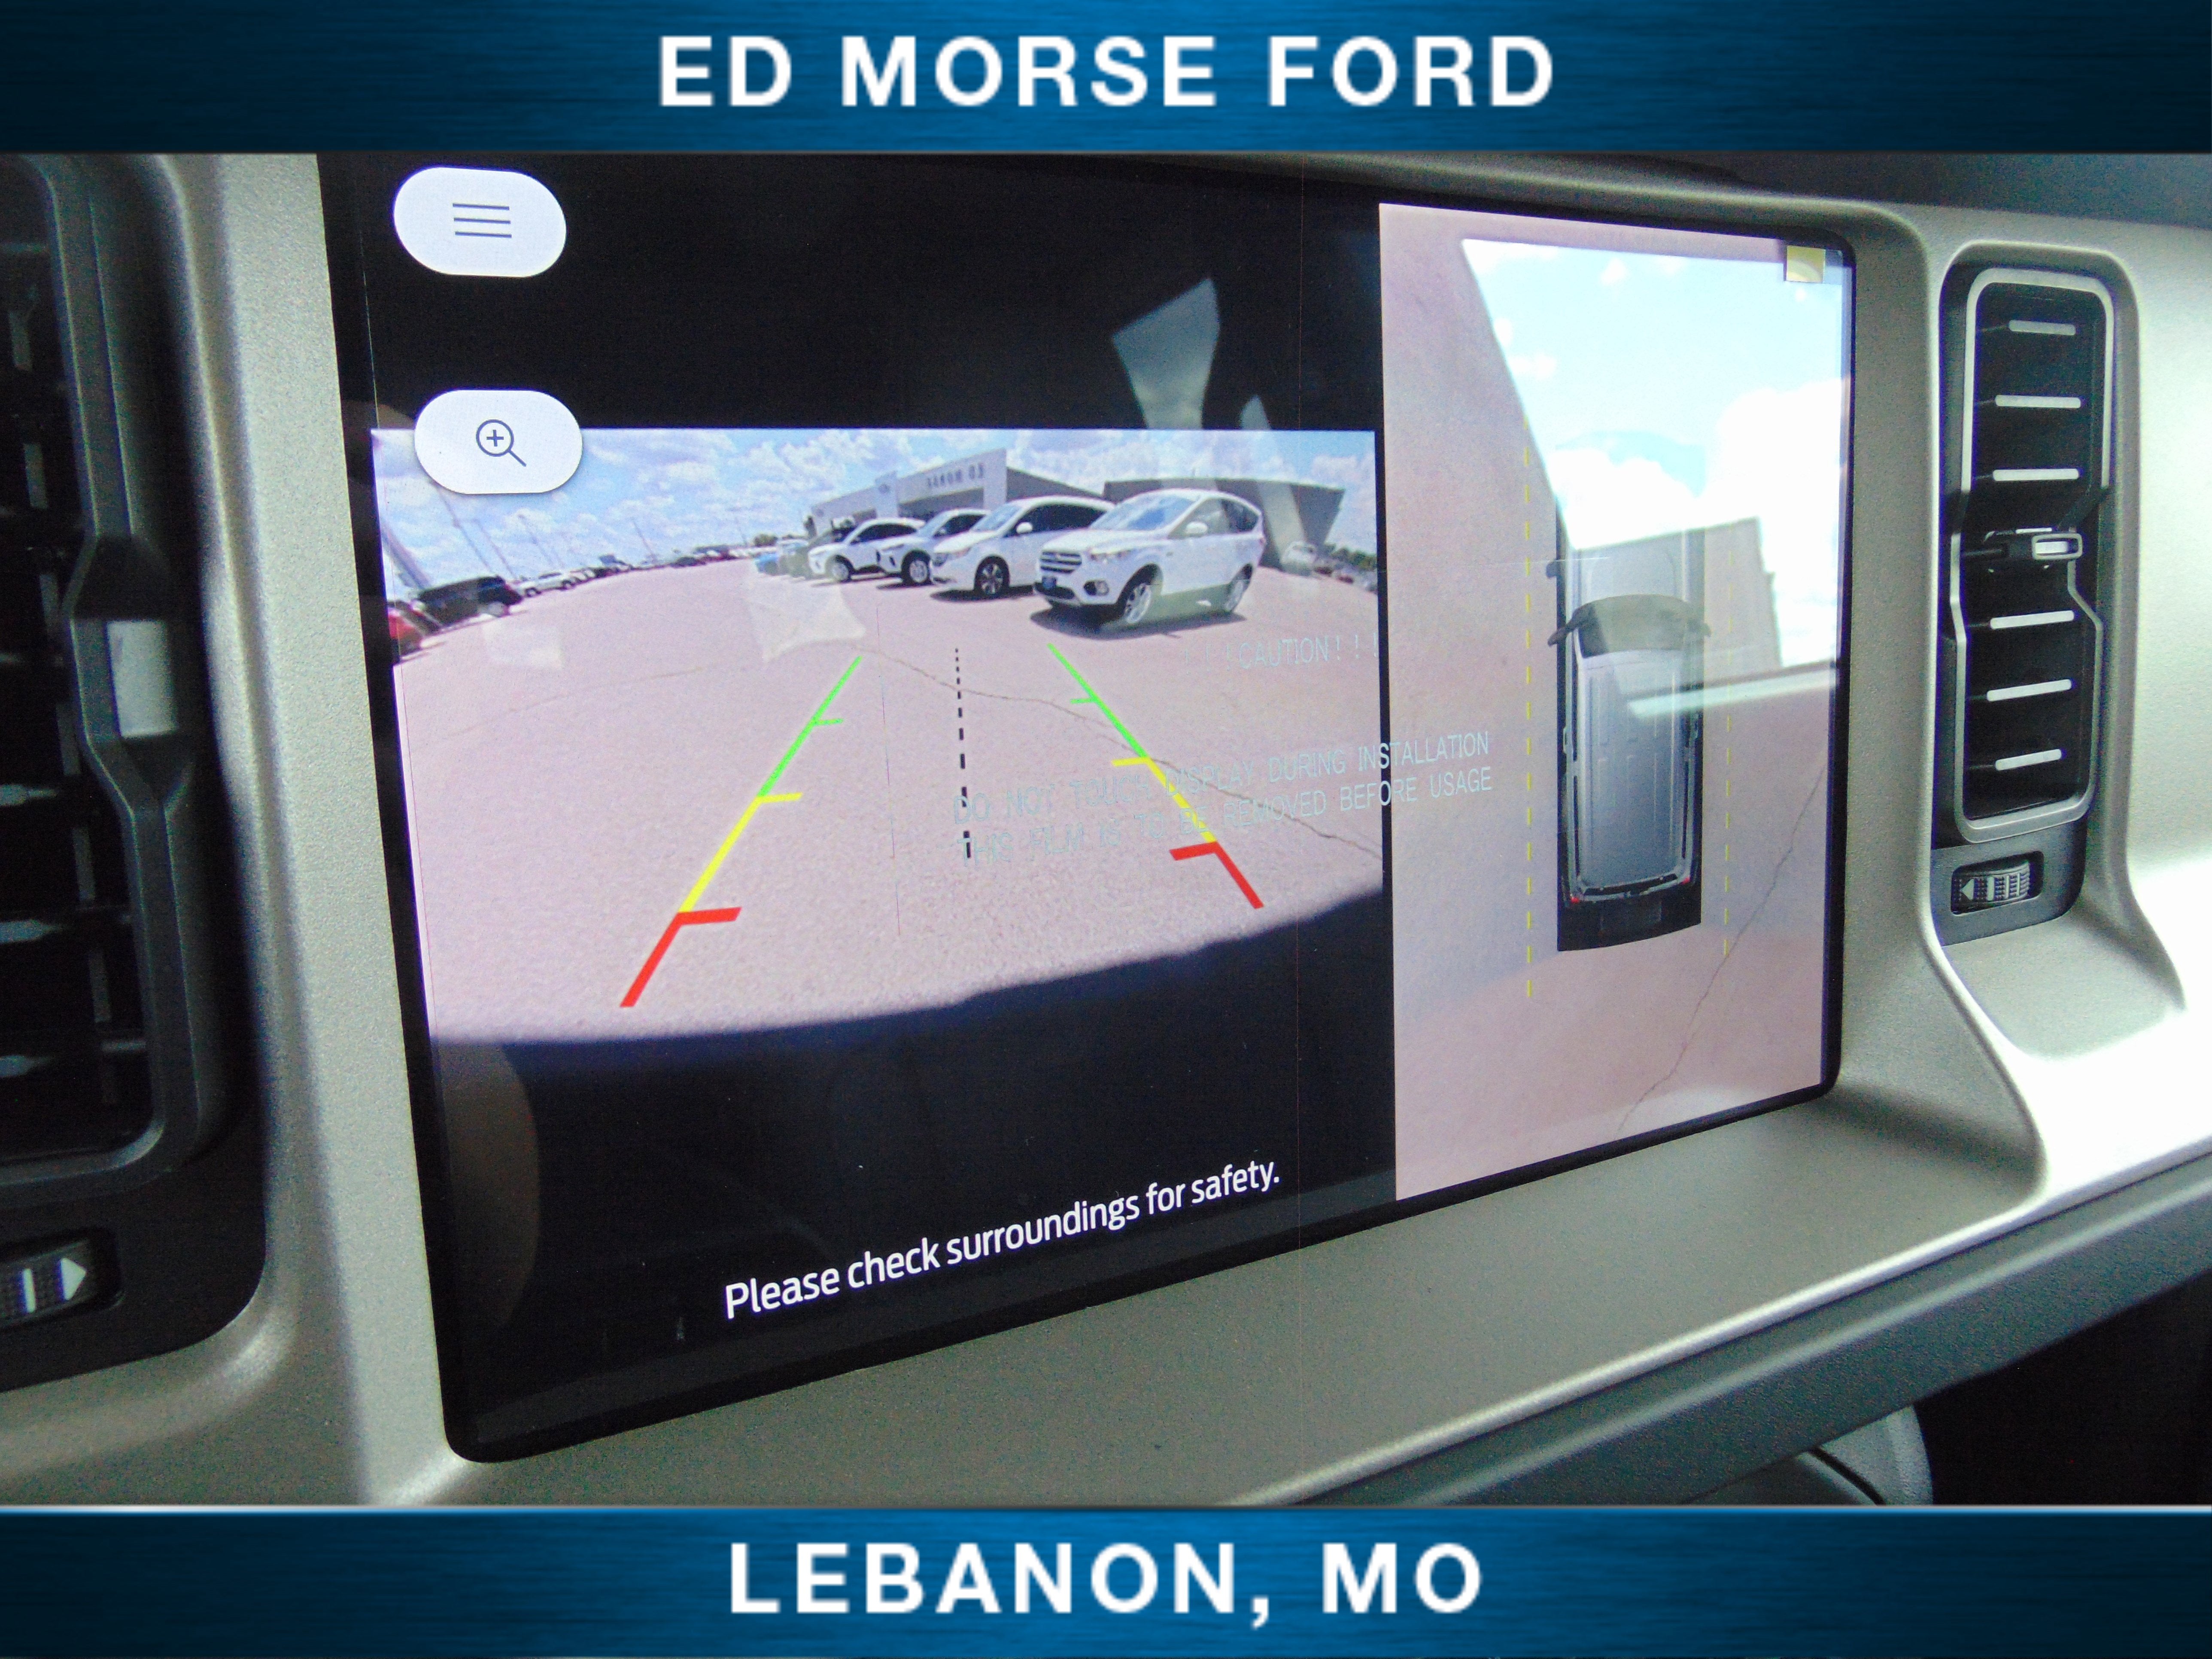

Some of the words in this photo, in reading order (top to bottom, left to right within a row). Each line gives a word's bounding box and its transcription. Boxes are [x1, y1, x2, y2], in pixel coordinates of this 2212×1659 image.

[953, 793, 991, 824] DO
[1006, 783, 1055, 817] NOT
[1070, 774, 1151, 809] TOUCH
[1164, 760, 1254, 797] DISPLAY
[1268, 749, 1346, 782] DURING
[1358, 731, 1489, 771] INSTALLATION
[957, 832, 1013, 867] THIS
[1030, 822, 1084, 859] FILM
[1099, 817, 1120, 848] IS
[1133, 812, 1164, 839] TO
[1179, 805, 1208, 835] BE
[1223, 789, 1326, 827] REMOVED
[1340, 777, 1417, 811] BEFORE
[1430, 766, 1492, 799] USAGE
[726, 1267, 840, 1319] Please
[848, 1237, 940, 1288] check
[947, 1195, 1140, 1265] surroundings
[1146, 1182, 1186, 1215] for
[1191, 1160, 1279, 1204] safety.
